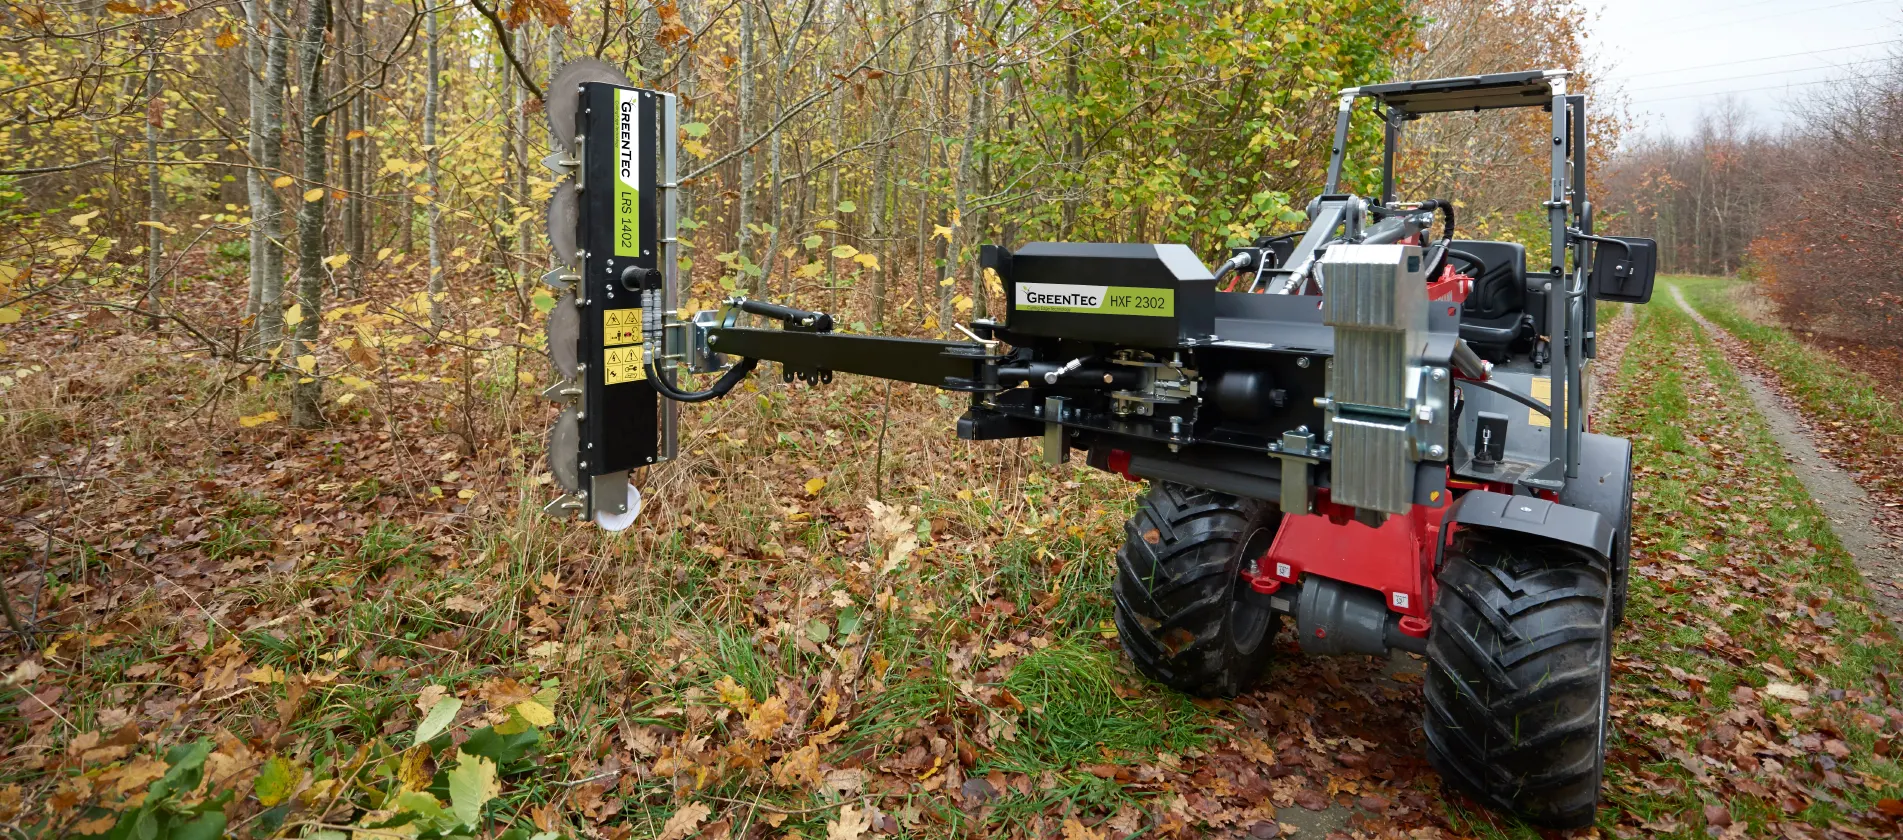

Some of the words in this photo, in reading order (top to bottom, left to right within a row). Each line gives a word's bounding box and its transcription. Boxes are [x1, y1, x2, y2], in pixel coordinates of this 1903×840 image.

[621, 191, 632, 214] LRS
[621, 217, 632, 249] 1402
[1110, 295, 1132, 308] HXF
[1134, 296, 1165, 310] 2302
